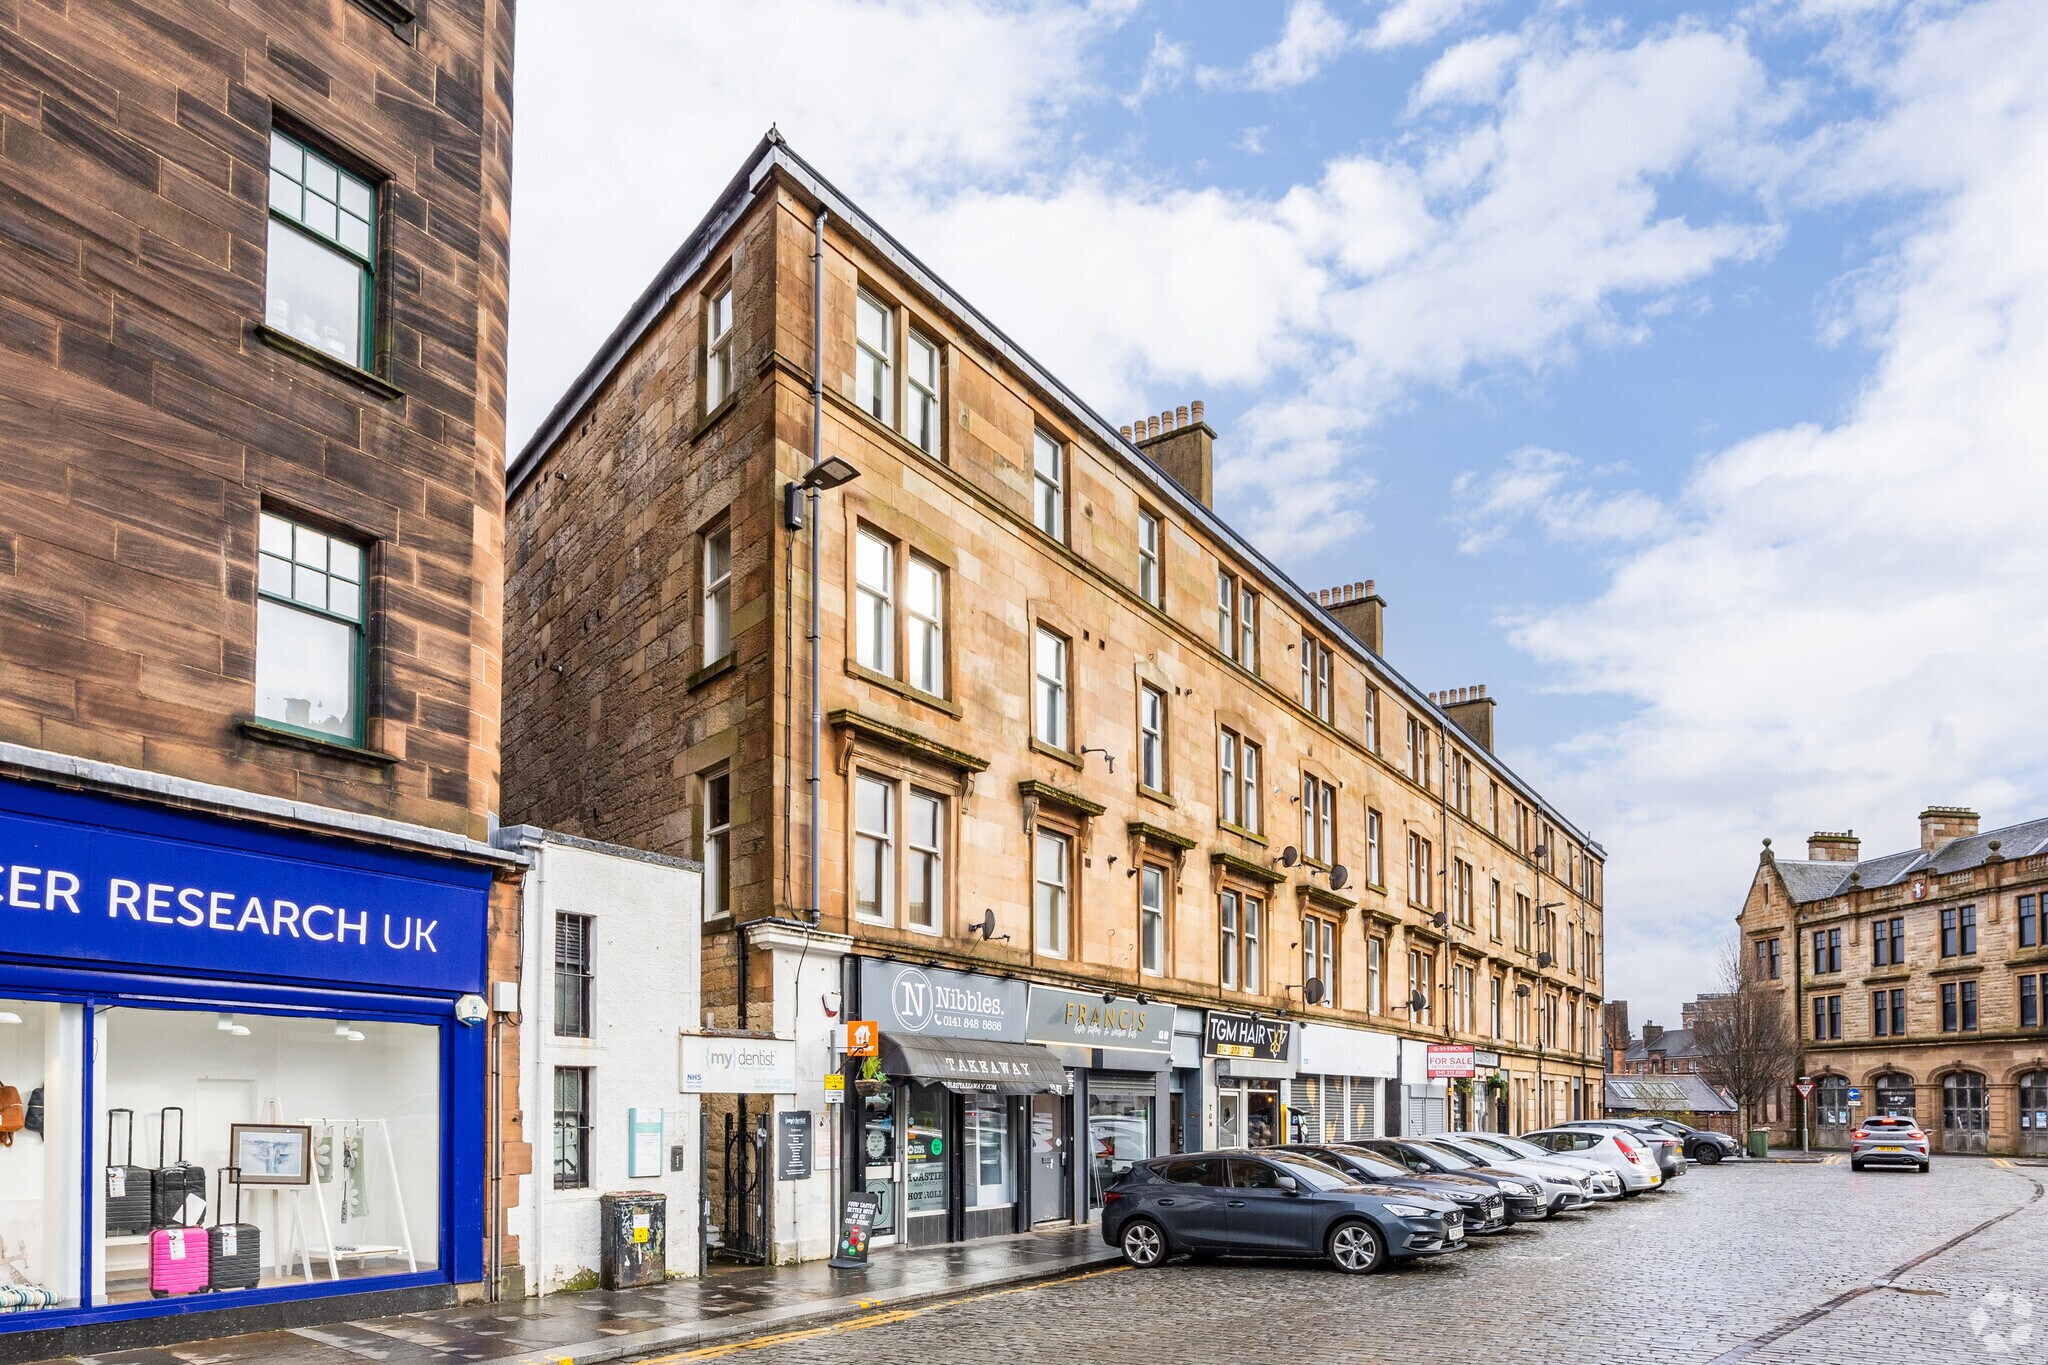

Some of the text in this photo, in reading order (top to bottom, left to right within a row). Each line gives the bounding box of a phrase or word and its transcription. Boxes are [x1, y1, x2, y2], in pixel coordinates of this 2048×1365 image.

[0, 865, 438, 953] ER RESEARCH UK
[901, 981, 1005, 1018] N Nibbles.
[943, 1016, 1002, 1031] 0141 848 5656
[1065, 1002, 1147, 1032] FRANCIS
[1211, 1018, 1265, 1045] TGM HAIR
[738, 1048, 775, 1067] dentist
[945, 1057, 1030, 1076] TAKEAWAY
[1430, 1057, 1447, 1065] FOR
[1450, 1057, 1472, 1065] SALE
[1292, 1115, 1298, 1123] P
[844, 1217, 856, 1225] COLD
